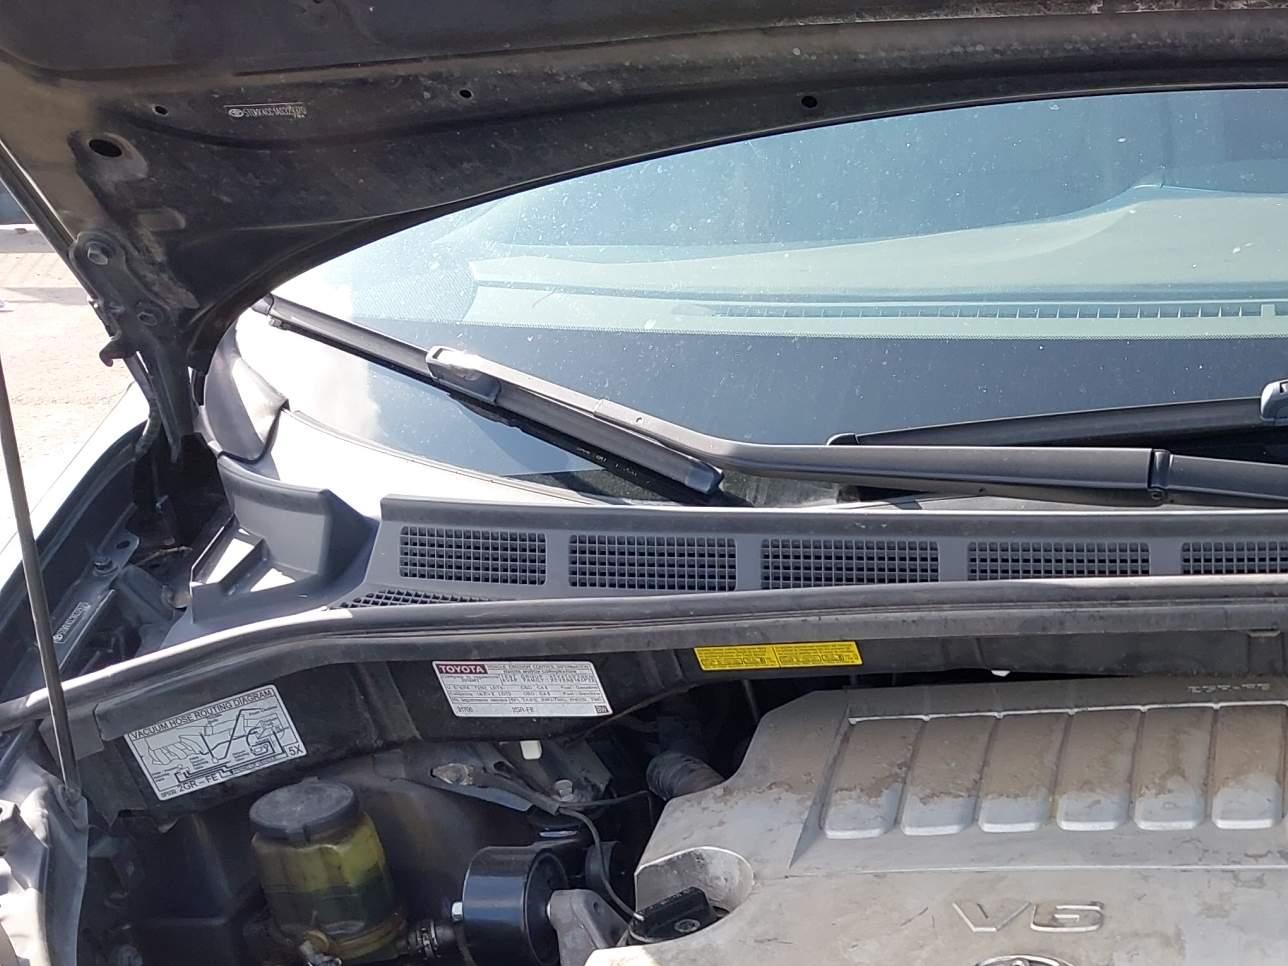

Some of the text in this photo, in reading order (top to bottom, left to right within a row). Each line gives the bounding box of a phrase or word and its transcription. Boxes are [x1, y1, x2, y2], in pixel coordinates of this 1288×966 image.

[439, 665, 485, 673] TOYOTA
[131, 719, 169, 740] VACUUM
[169, 712, 193, 728] HOSE
[194, 702, 233, 720] ROUTING
[233, 690, 273, 707] DIAGRAM
[289, 745, 305, 757] 5X
[952, 900, 1106, 934] V6
